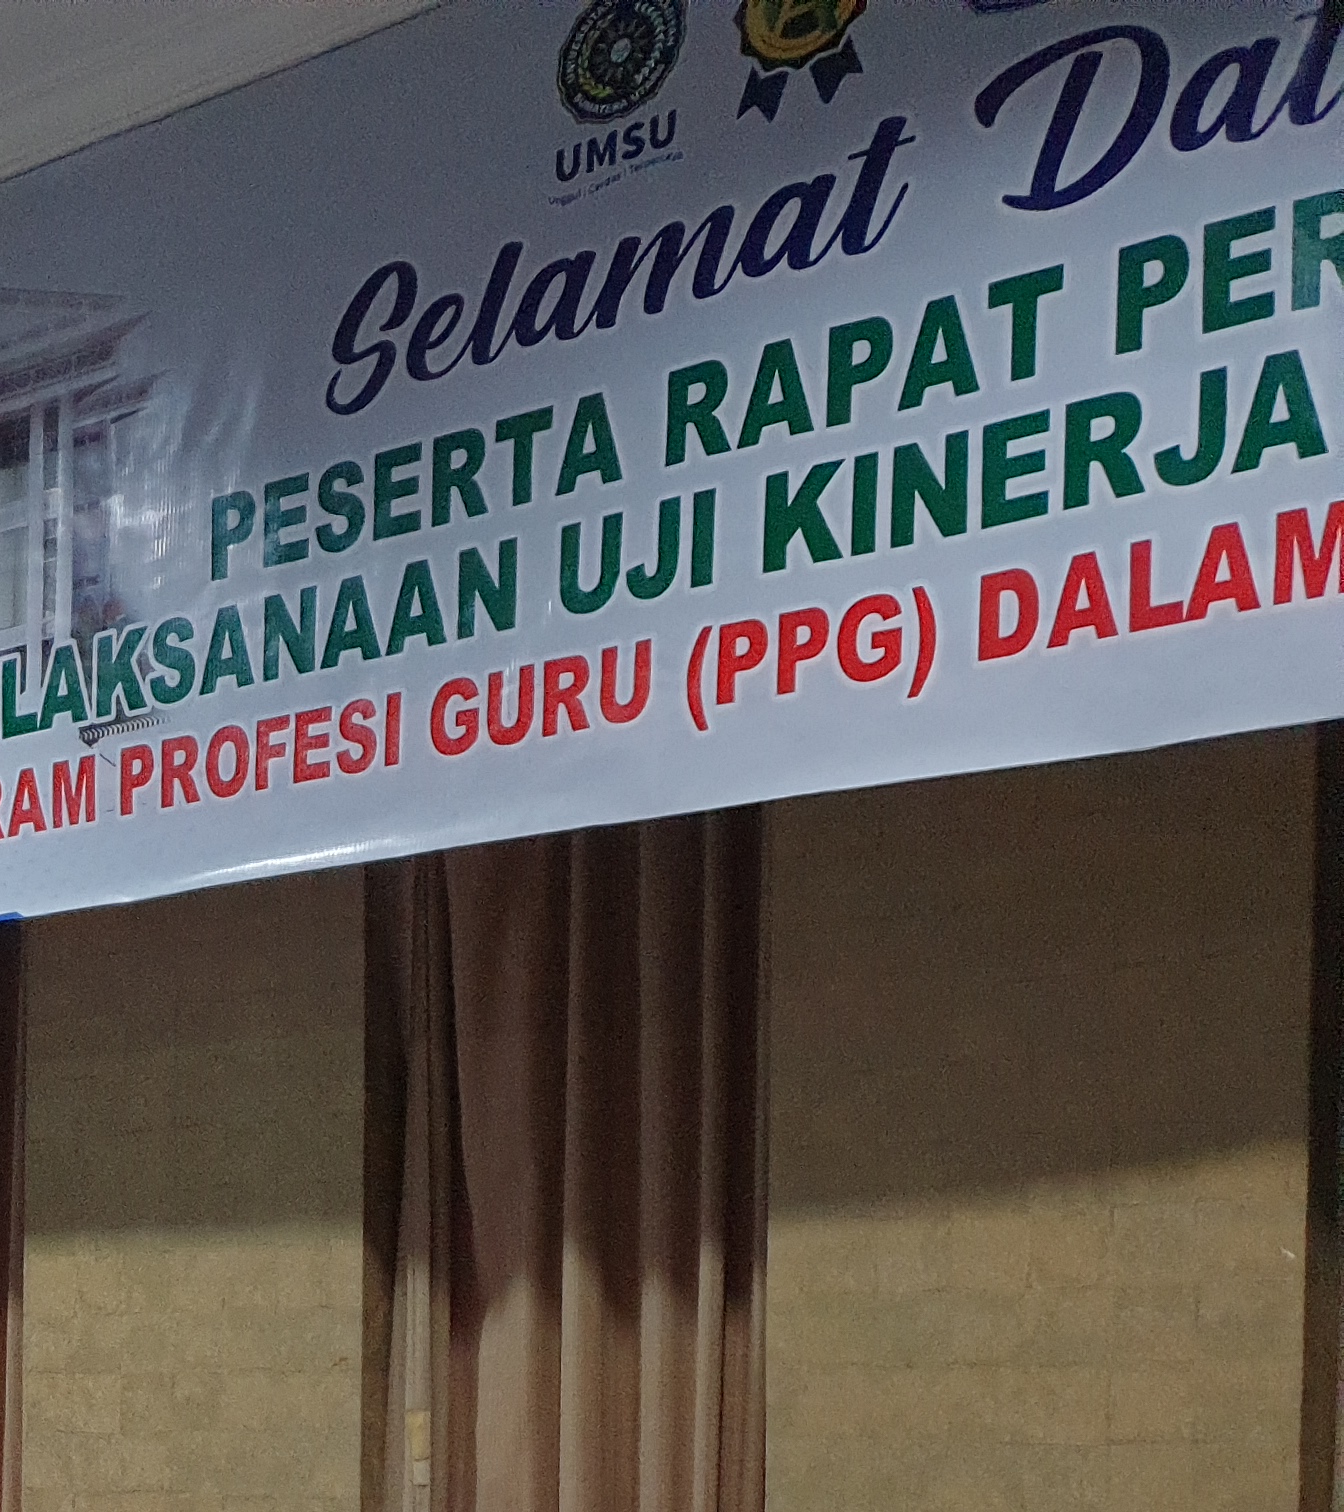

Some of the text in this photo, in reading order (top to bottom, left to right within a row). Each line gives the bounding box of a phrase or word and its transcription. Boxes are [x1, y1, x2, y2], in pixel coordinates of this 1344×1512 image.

[325, 116, 916, 416] Selamat
[555, 108, 677, 182] UMSU
[211, 188, 1344, 582] PESERTA RAPAT PER
[558, 487, 717, 616] UJI
[761, 349, 1329, 574] KINERJA
[119, 691, 402, 817] PROFESI
[429, 638, 653, 756] GURU
[686, 585, 938, 732] (PPG)
[977, 500, 1344, 662] DALAM
